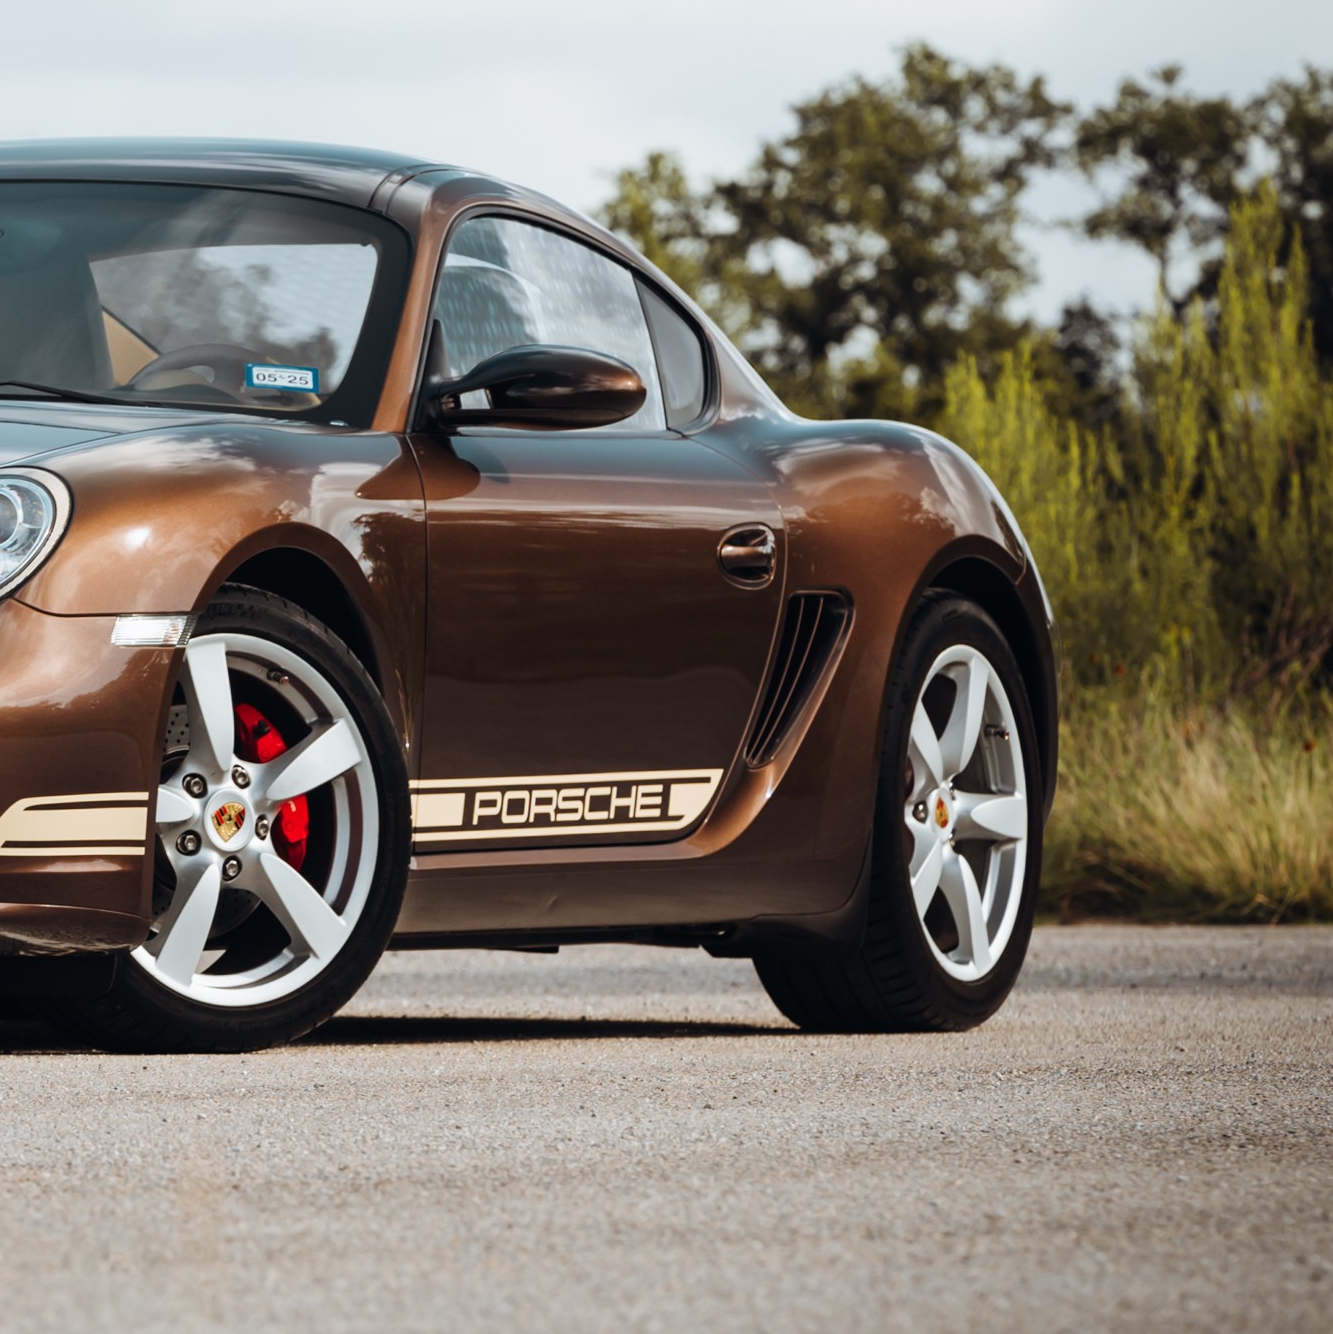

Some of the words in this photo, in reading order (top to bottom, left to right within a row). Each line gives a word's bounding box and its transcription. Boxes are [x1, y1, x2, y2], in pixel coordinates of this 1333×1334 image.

[256, 372, 278, 383] 05
[287, 375, 309, 385] 25
[472, 784, 664, 826] PORSCHE
